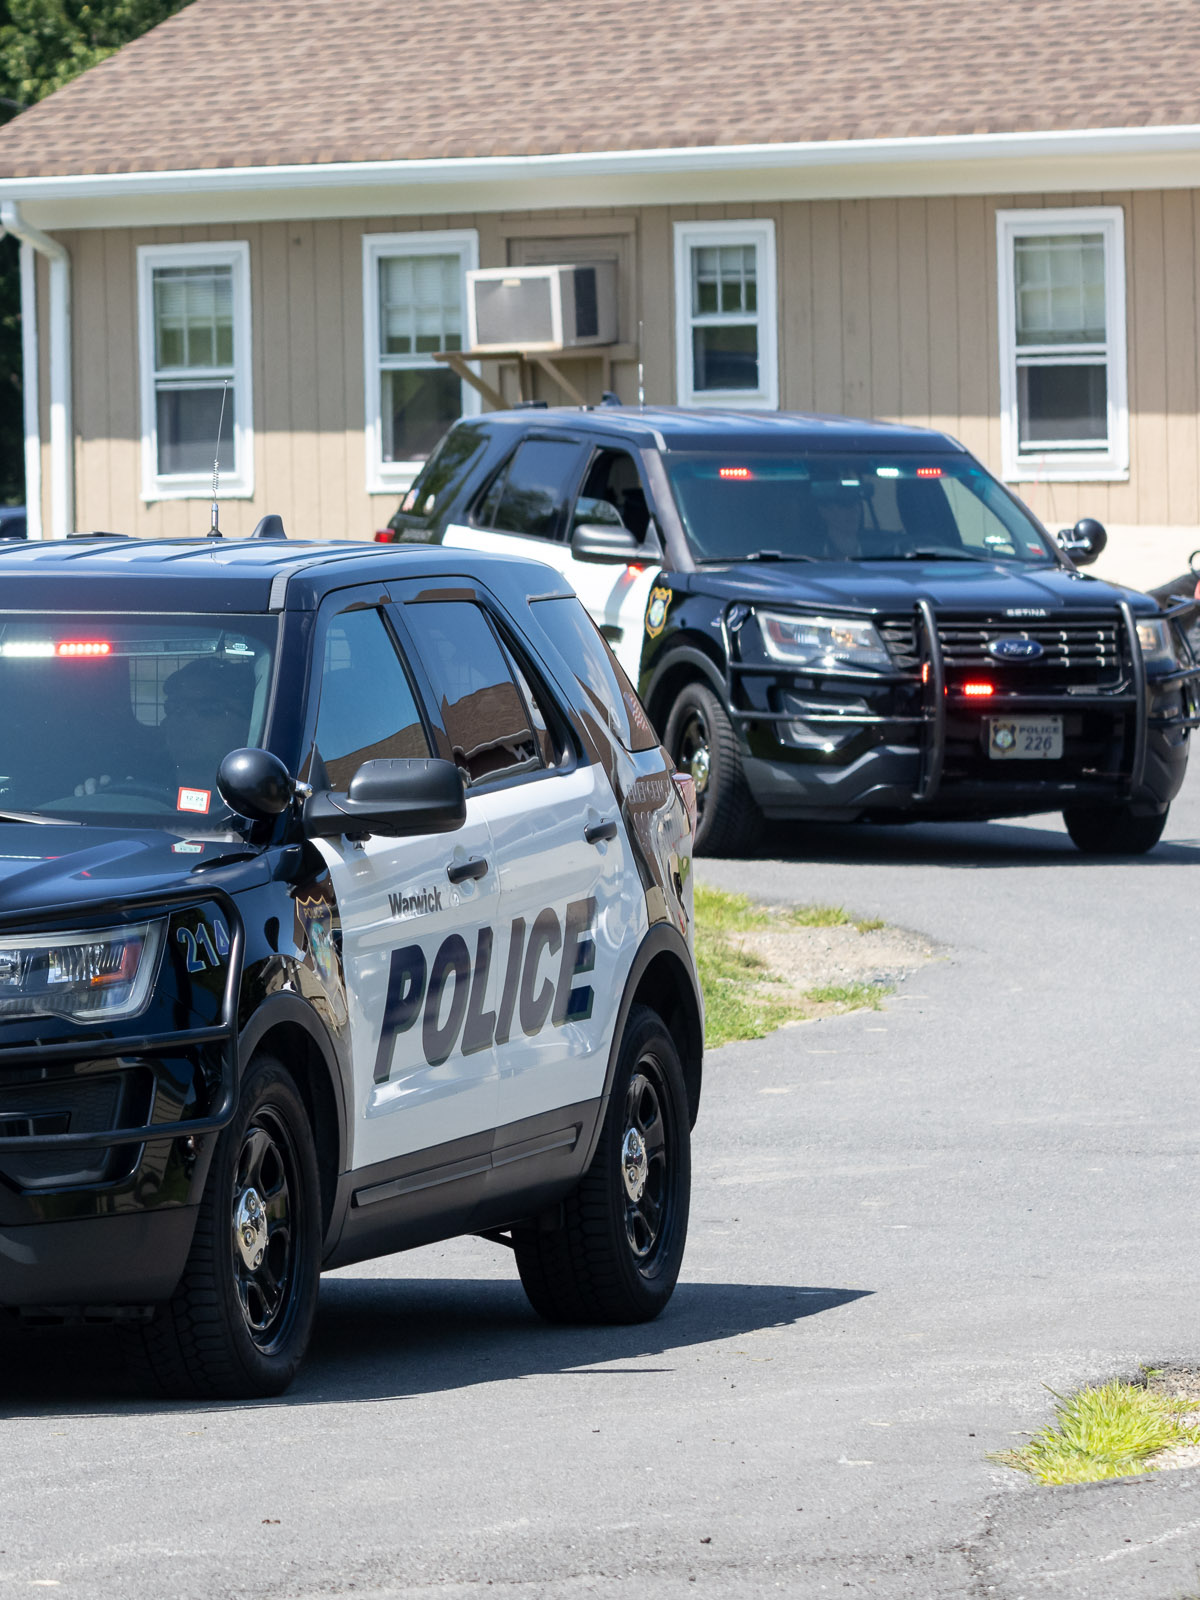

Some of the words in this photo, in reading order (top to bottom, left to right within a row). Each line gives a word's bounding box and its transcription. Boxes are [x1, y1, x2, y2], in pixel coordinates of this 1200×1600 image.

[1019, 725, 1059, 734] POLICE
[1024, 736, 1052, 751] 226
[388, 886, 443, 917] Warwick
[303, 906, 325, 919] POLICE
[373, 896, 599, 1085] POLICE
